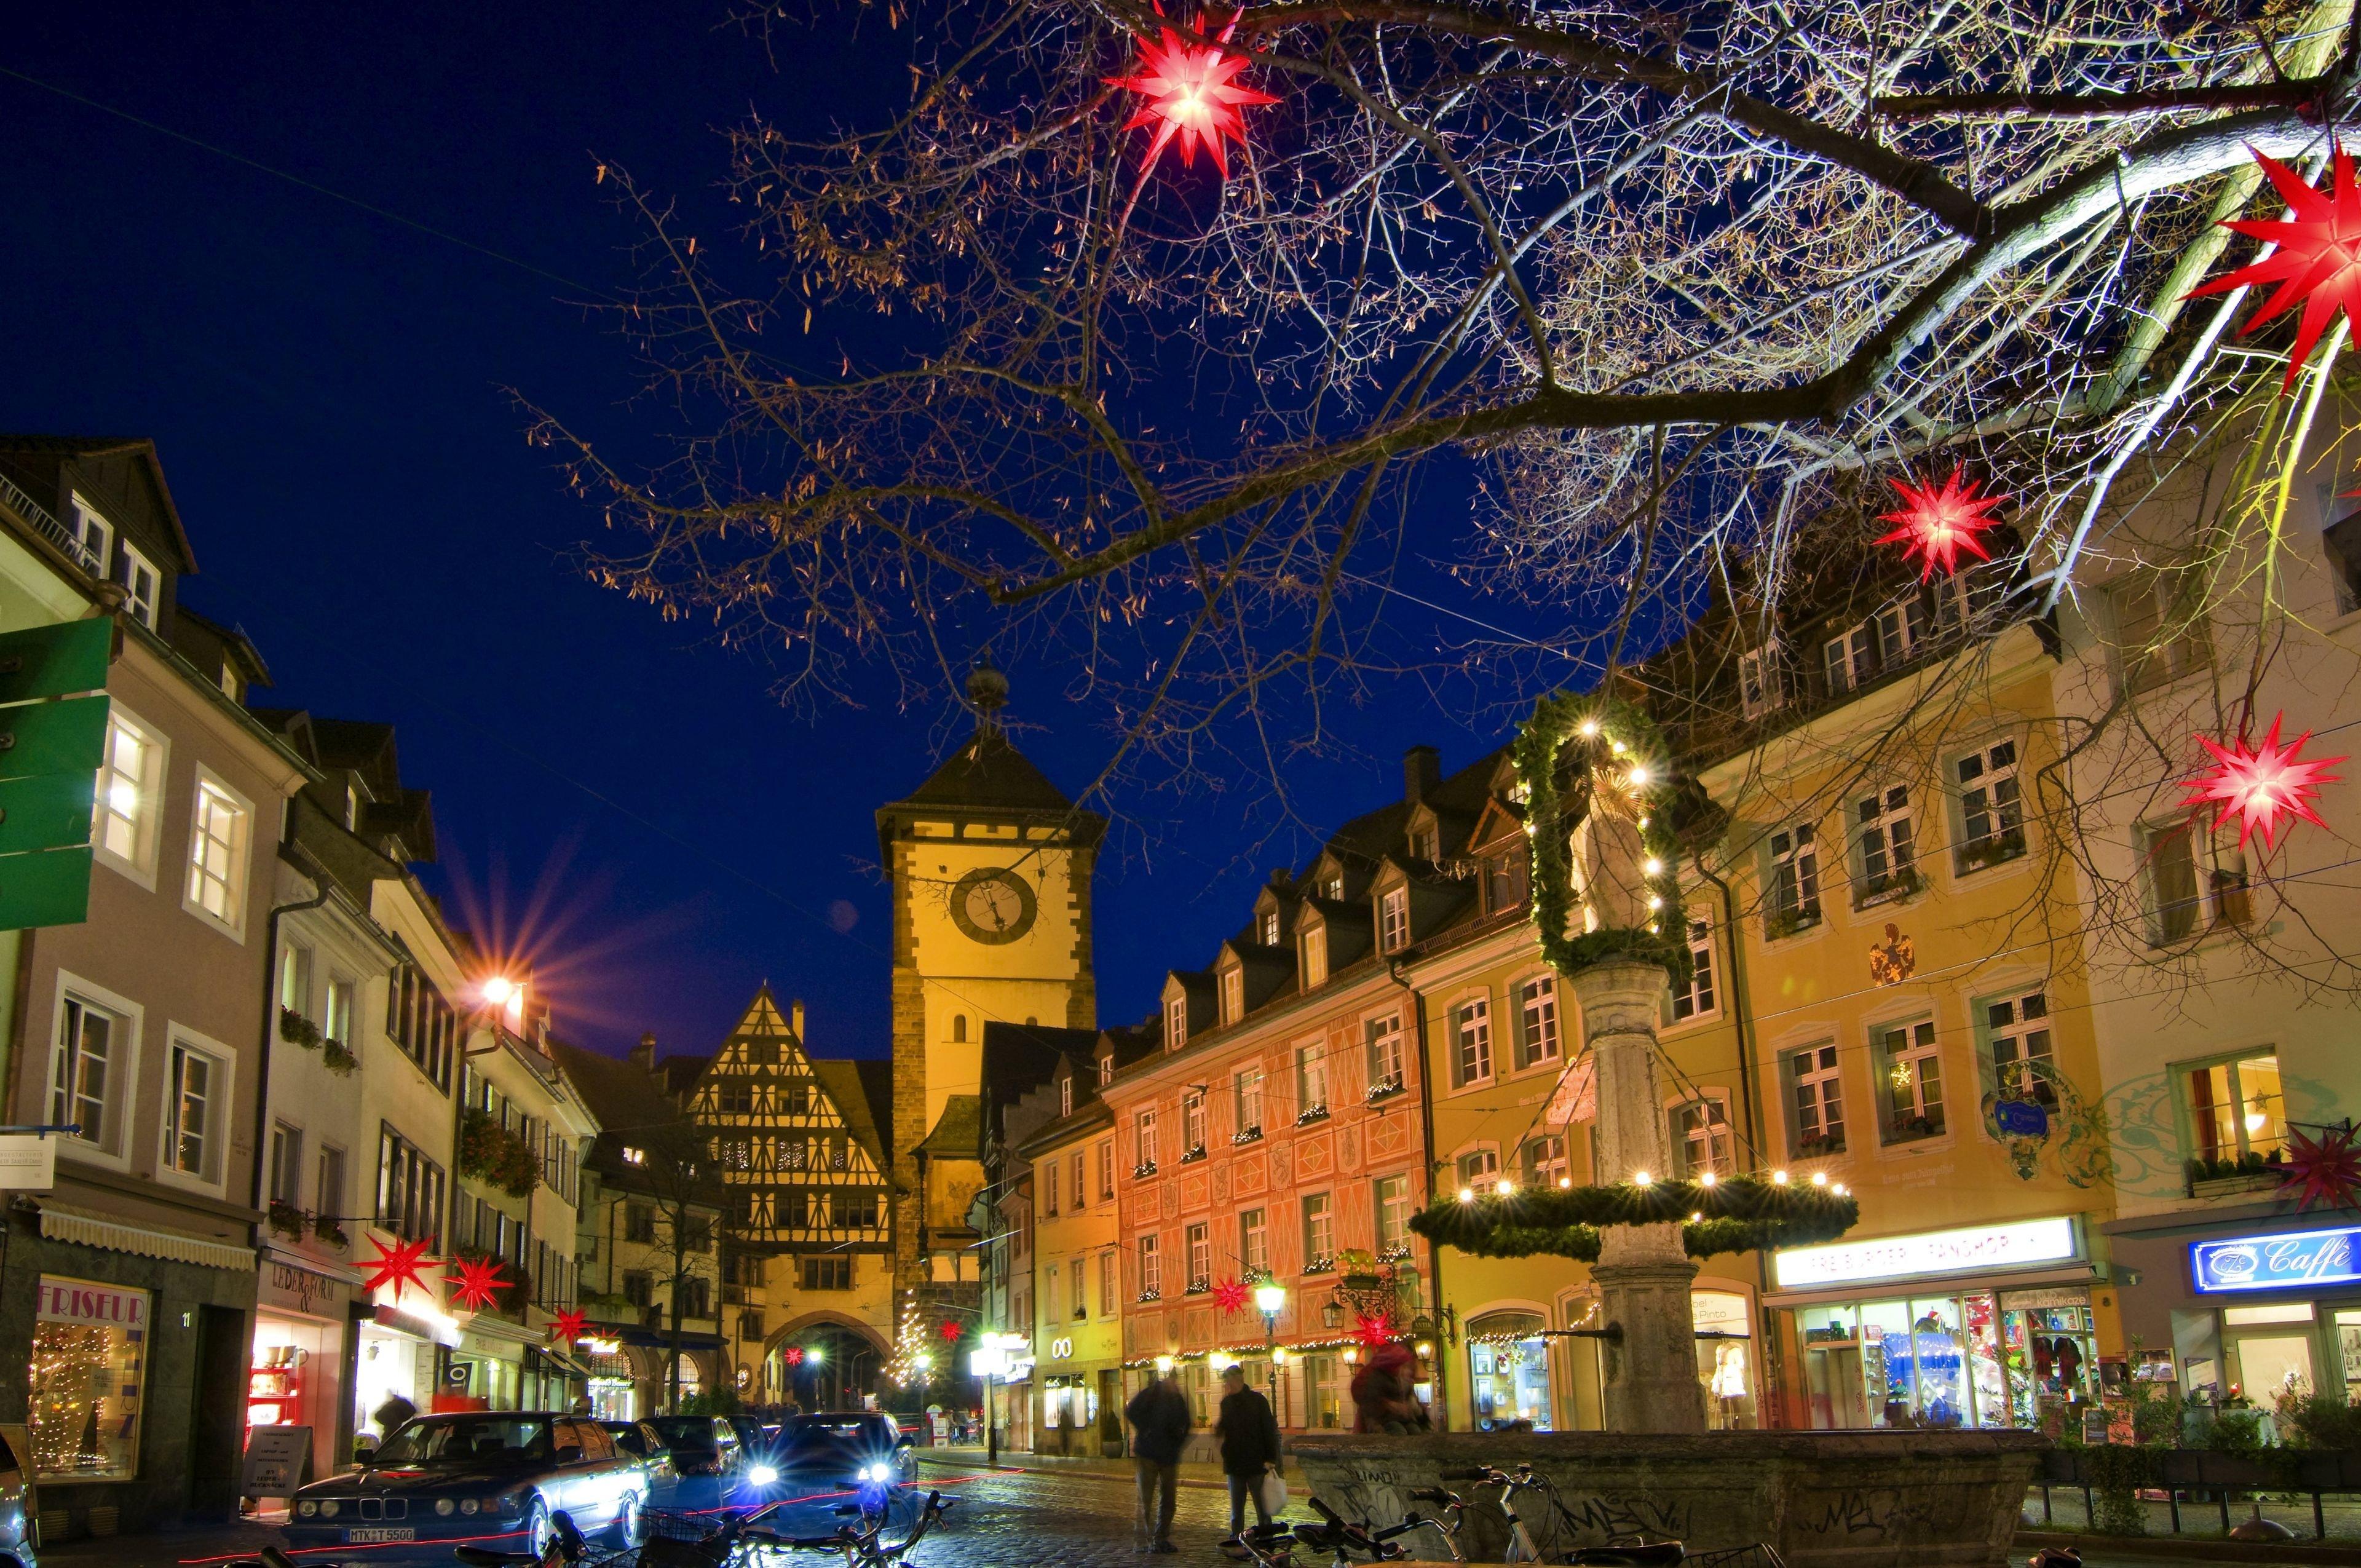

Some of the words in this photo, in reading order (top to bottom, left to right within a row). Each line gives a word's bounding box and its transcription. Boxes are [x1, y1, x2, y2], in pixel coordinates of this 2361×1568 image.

[1811, 1247, 1906, 1273] FREBRGER
[1929, 1235, 2009, 1261] FANSHOP
[2264, 1237, 2351, 1278] Caffè
[272, 1264, 304, 1293] LEDER
[310, 1275, 334, 1301] FORM
[2036, 1289, 2057, 1299] klub
[2037, 1296, 2087, 1308] kamikaze
[37, 1285, 145, 1324] FRISEUR
[182, 1312, 191, 1328] 11
[1220, 1309, 1255, 1326] HOTEL
[1699, 1310, 1726, 1319] Pinto
[351, 1529, 370, 1541] MTK
[378, 1530, 385, 1541] T
[387, 1529, 413, 1541] 5500
